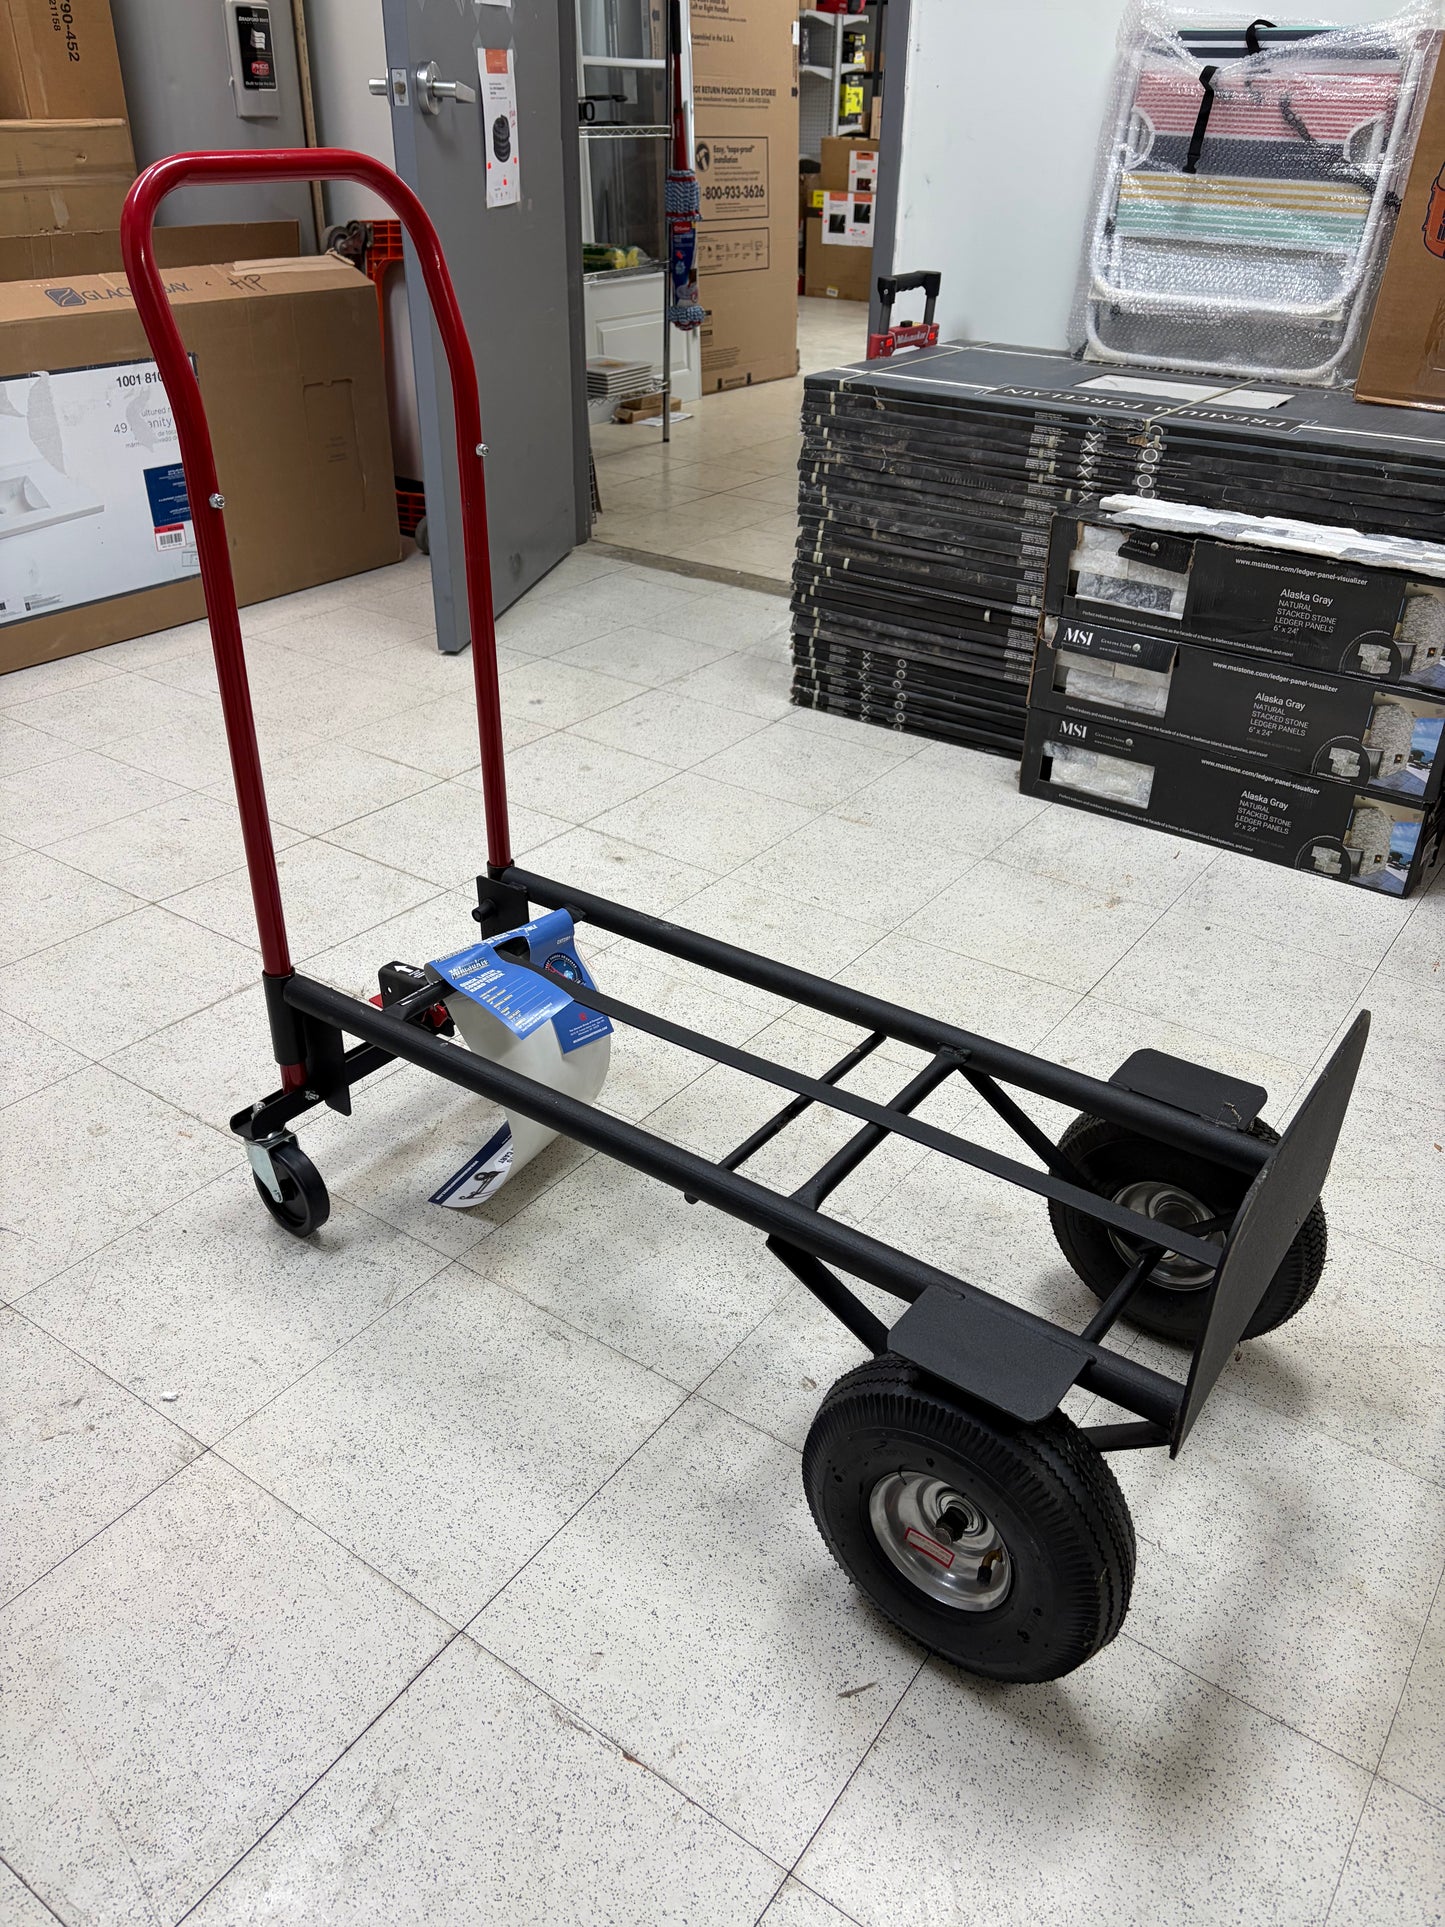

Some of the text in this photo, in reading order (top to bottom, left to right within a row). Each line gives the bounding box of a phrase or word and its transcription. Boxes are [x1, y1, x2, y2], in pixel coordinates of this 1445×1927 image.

[61, 0, 80, 61] 90-452
[702, 86, 720, 94] RETURN
[721, 87, 744, 95] PRODUCT
[752, 88, 760, 96] THE
[713, 145, 725, 153] Easy,
[714, 155, 738, 163] installation
[702, 184, 765, 199] -800-933-3626
[116, 374, 141, 387] 1001
[141, 407, 166, 417] ultured
[1002, 388, 1287, 428] PREMIUM PORCELAIN
[147, 417, 171, 428] anity
[1235, 558, 1368, 586] www.msistone.com/ledger-panel-visualizer
[1278, 600, 1312, 612] NATURAL
[1280, 588, 1334, 607] Alaska Gray
[1275, 616, 1334, 633] LEDGER PANELS
[1276, 608, 1337, 625] STACKED STONE
[1063, 627, 1094, 646] MSI
[1212, 661, 1338, 693] www.msistone.com/ledger-panel-visualizer
[1253, 702, 1286, 716] NATURAL
[1255, 692, 1306, 712] Alaska Gray
[1250, 718, 1306, 737] LEDGER PANELS
[1252, 710, 1310, 729] STACKED STONE
[1059, 720, 1088, 739] MSI
[1201, 759, 1320, 795] www.msistone.com/ledger-panel-visualizer
[1239, 800, 1270, 814] NATURAL
[1241, 790, 1288, 811] Alaska Gray
[1236, 814, 1289, 835] LEDGER PANELS
[1238, 807, 1292, 828] STACKED STONE
[448, 957, 490, 980] Milwaukee
[459, 976, 477, 988] QUICK
[464, 970, 503, 990] CONVERTIBLE
[469, 982, 487, 993] HAND
[487, 973, 506, 984] TRUCK
